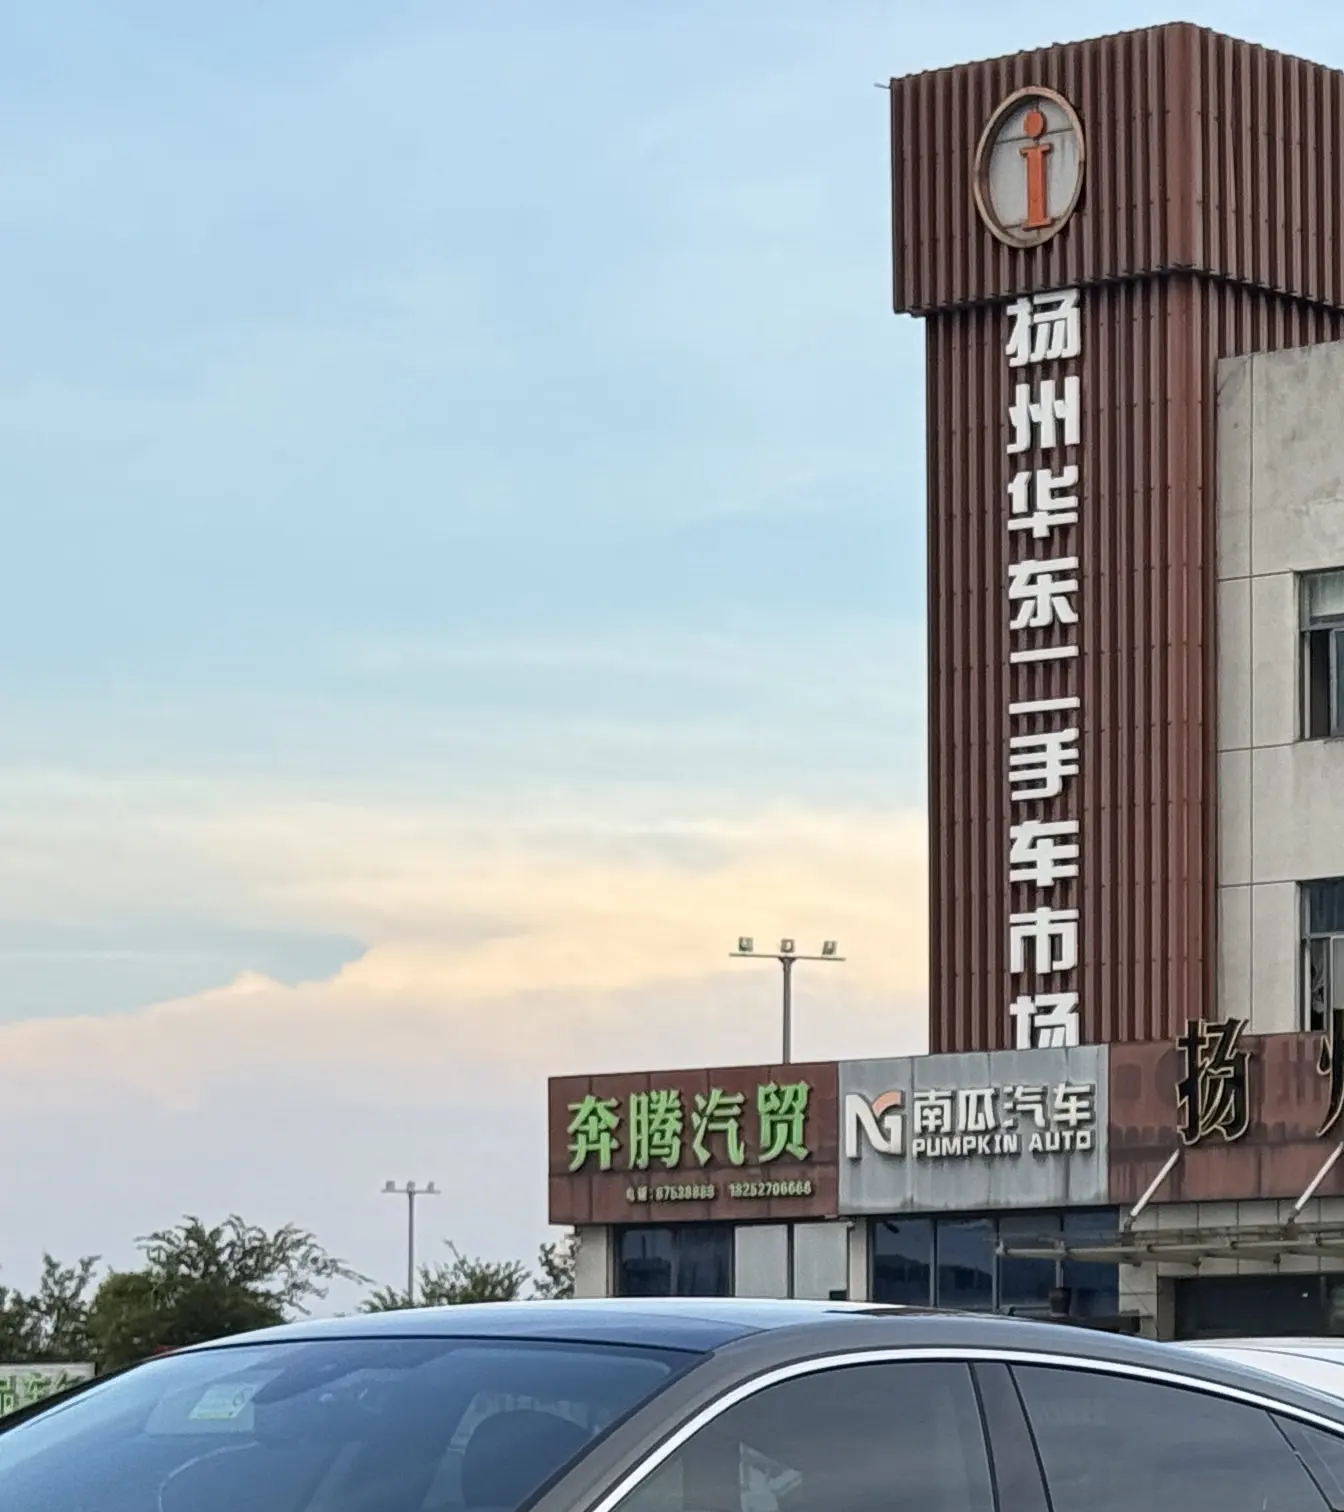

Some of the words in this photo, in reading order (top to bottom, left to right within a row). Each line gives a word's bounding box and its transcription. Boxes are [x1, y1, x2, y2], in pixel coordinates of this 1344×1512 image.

[1006, 288, 1081, 1050] 扬州华东二手车市场
[566, 1080, 814, 1173] 奔腾汽贸
[912, 1133, 1018, 1158] PUMPKIN
[1028, 1130, 1091, 1154] AUTO
[914, 1082, 1092, 1134] 南瓜汽车
